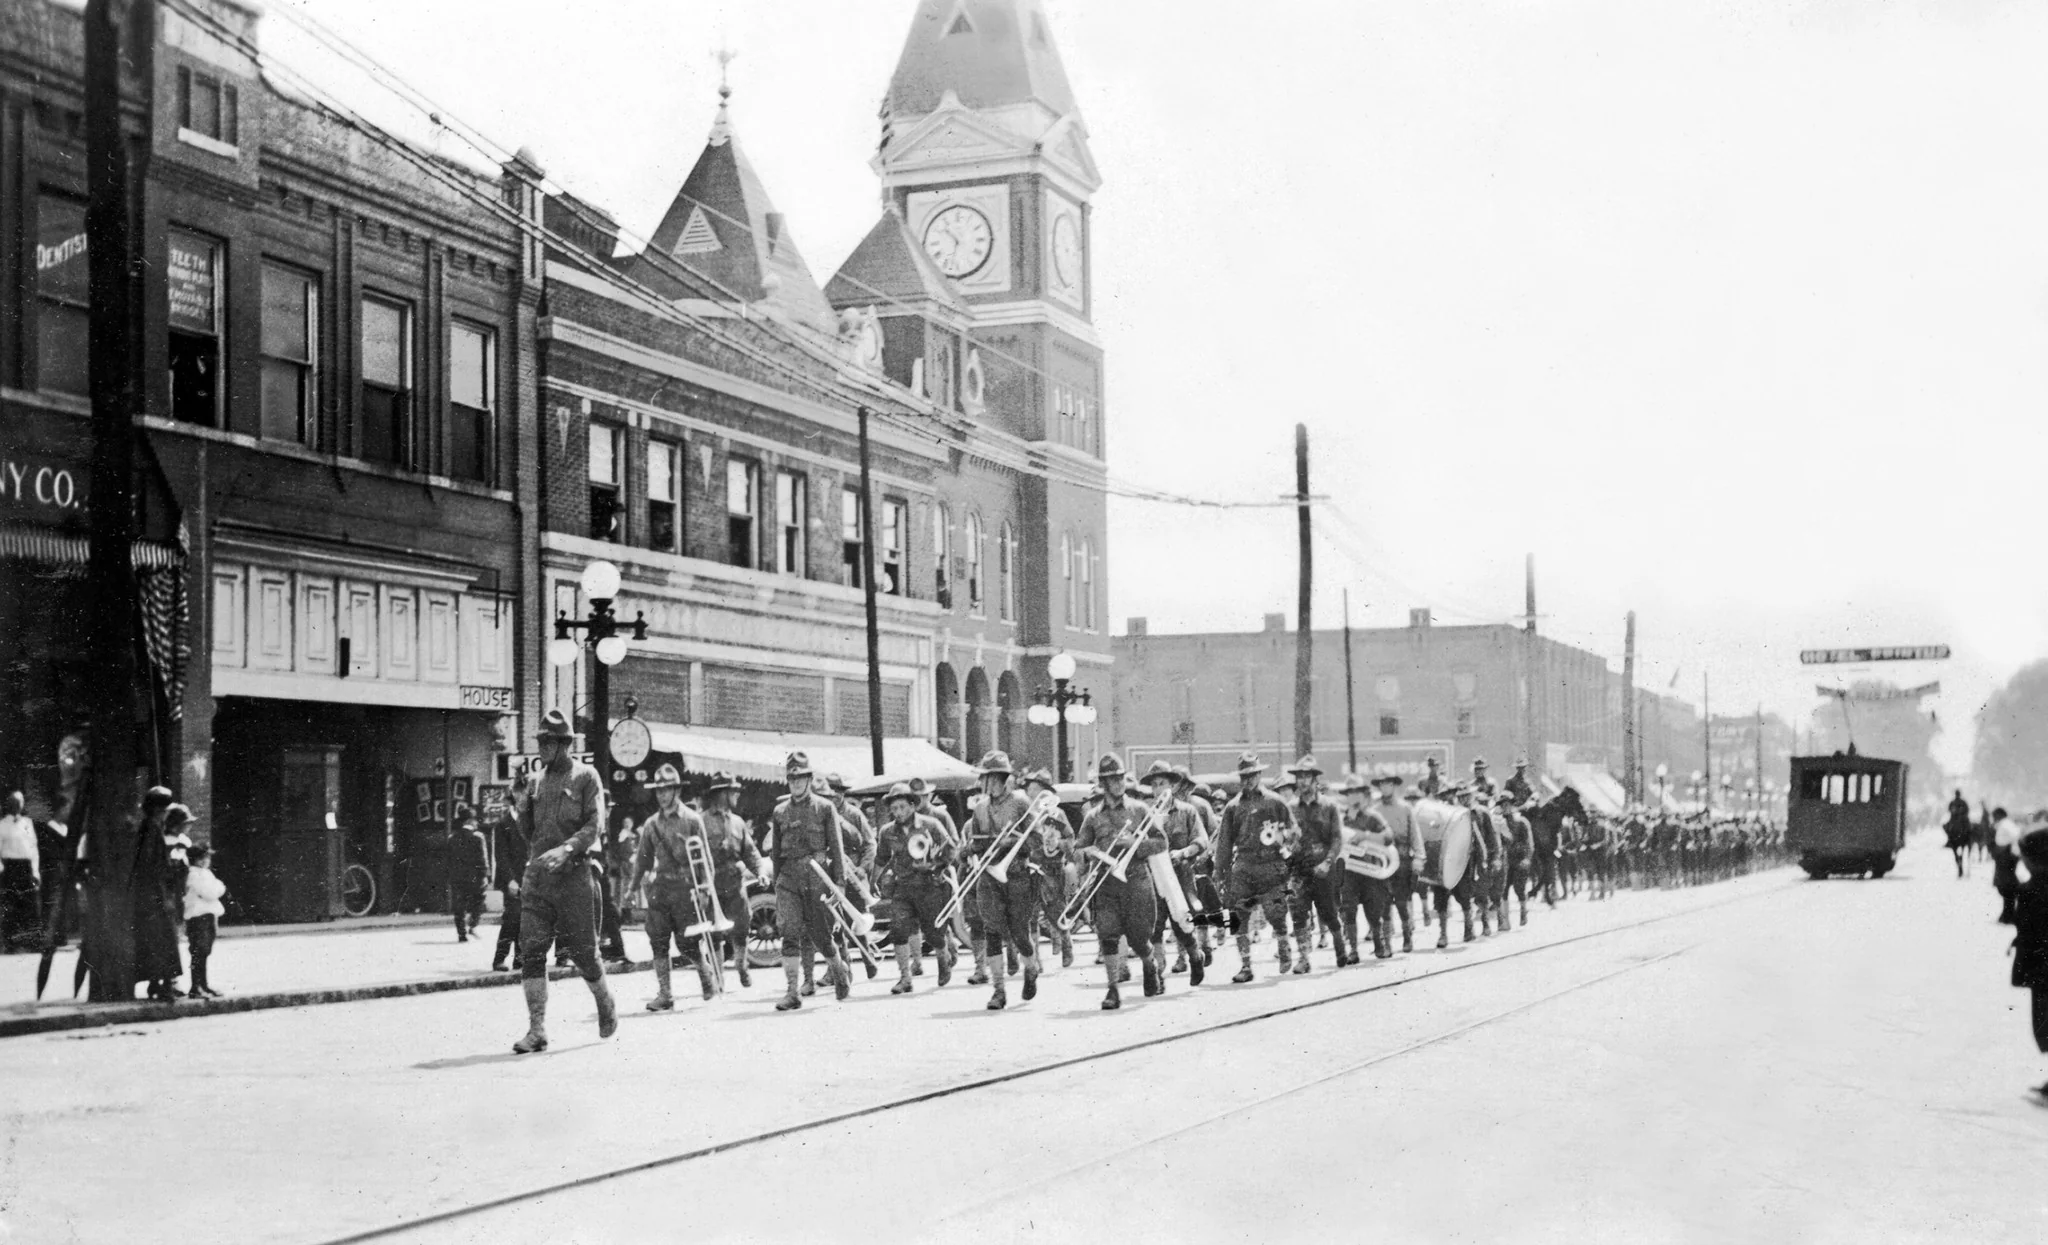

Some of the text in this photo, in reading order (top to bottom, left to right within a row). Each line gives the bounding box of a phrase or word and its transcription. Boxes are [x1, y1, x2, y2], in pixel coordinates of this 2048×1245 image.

[37, 232, 87, 269] DENTIST
[35, 466, 79, 509] CO.
[463, 687, 509, 707] HOUSE
